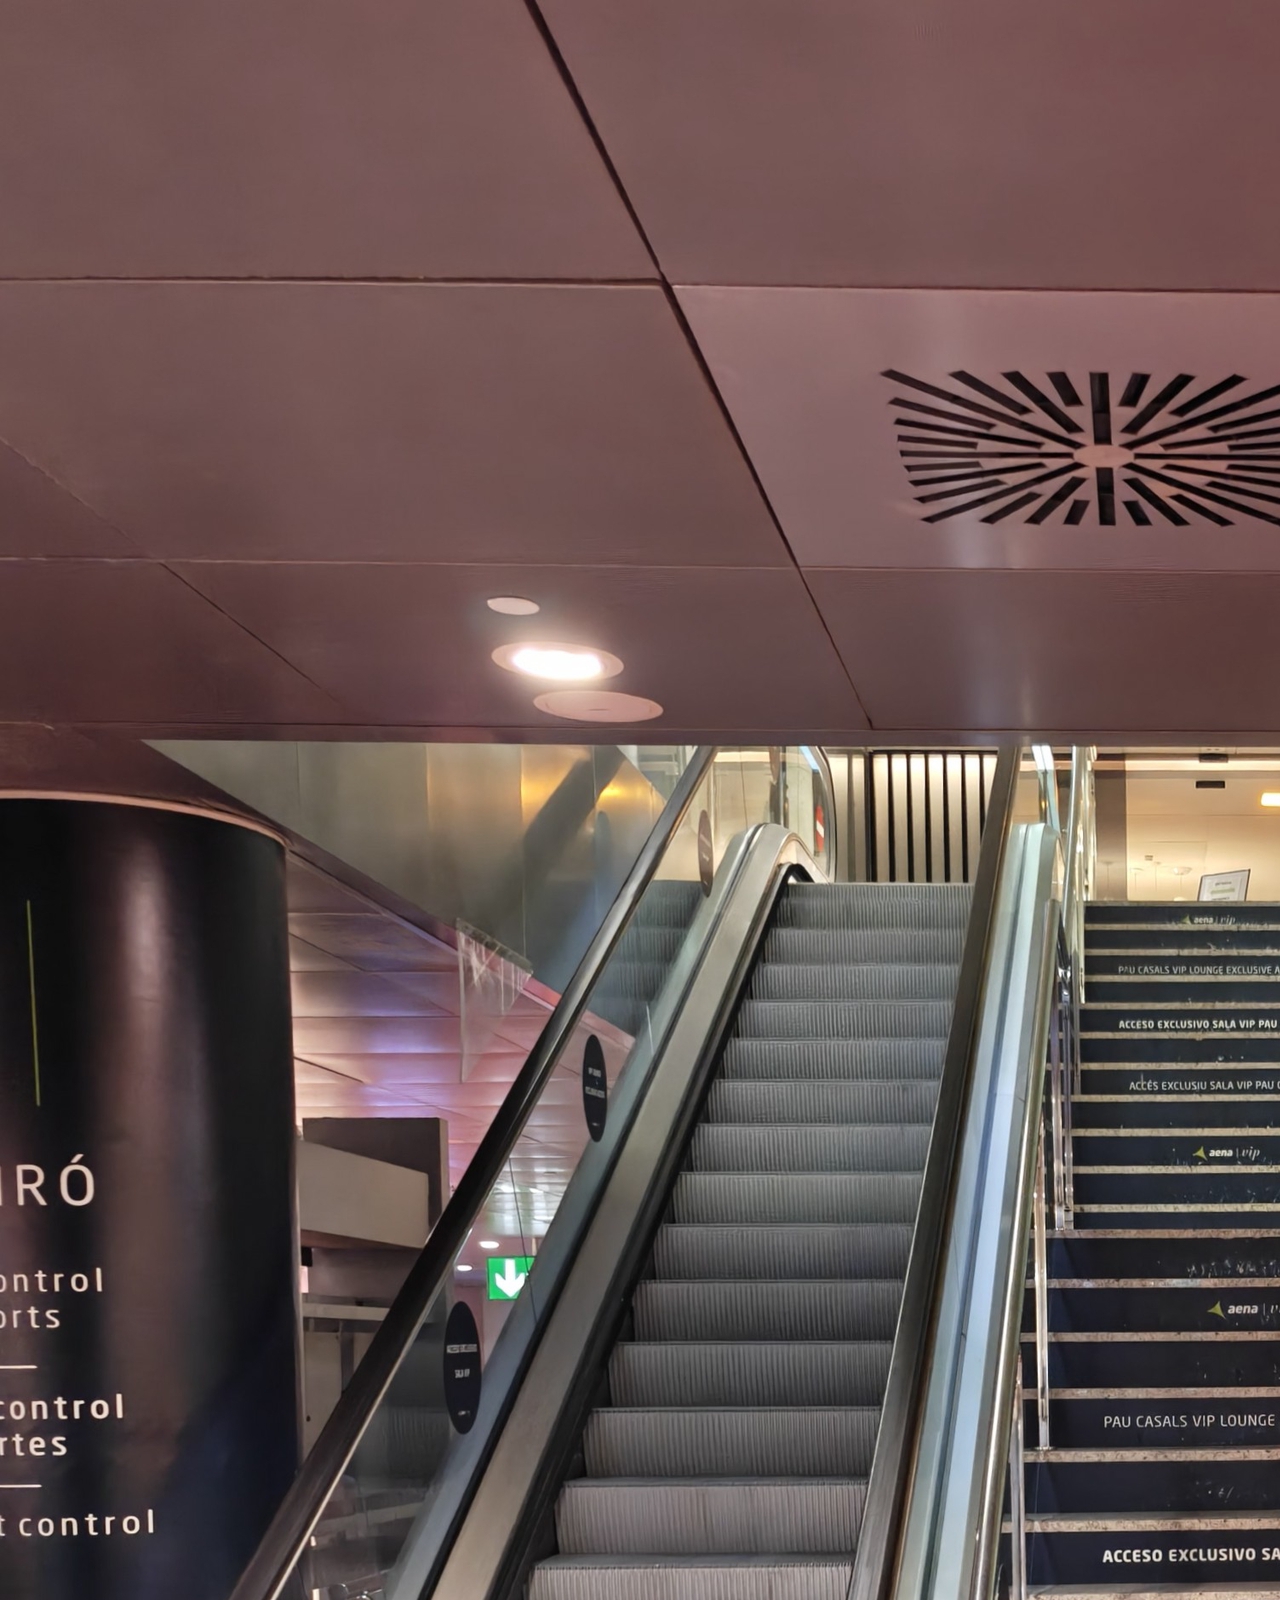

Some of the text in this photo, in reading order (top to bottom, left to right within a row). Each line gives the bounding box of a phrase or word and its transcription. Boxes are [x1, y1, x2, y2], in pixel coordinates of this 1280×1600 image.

[1119, 966, 1135, 974] PAU
[1138, 966, 1169, 974] CASALS
[1173, 966, 1186, 974] VIP
[1190, 966, 1223, 975] LOUNGE
[1226, 966, 1271, 975] EXCLUSIVE
[1119, 1021, 1154, 1029] ACCESO
[1158, 1020, 1209, 1028] EXCLUSIVO
[1212, 1020, 1236, 1028] SALA
[1239, 1020, 1255, 1028] VIP
[1259, 1020, 1277, 1028] PAU
[1130, 1080, 1158, 1090] ACCÉS
[1162, 1082, 1206, 1090] EXCLUSIU
[1210, 1081, 1233, 1090] SALA
[1237, 1081, 1252, 1089] VIP
[1256, 1081, 1274, 1089] PAU
[1209, 1147, 1260, 1160] aena vip
[1228, 1305, 1258, 1314] aena
[1104, 1416, 1130, 1427] PAU
[1136, 1416, 1187, 1427] CASALS
[1193, 1415, 1215, 1427] VIP
[1221, 1414, 1274, 1426] LOUNGE
[19, 1509, 153, 1536] control
[1103, 1549, 1162, 1562] ACCESO
[1169, 1548, 1255, 1561] EXCLUSIVO
